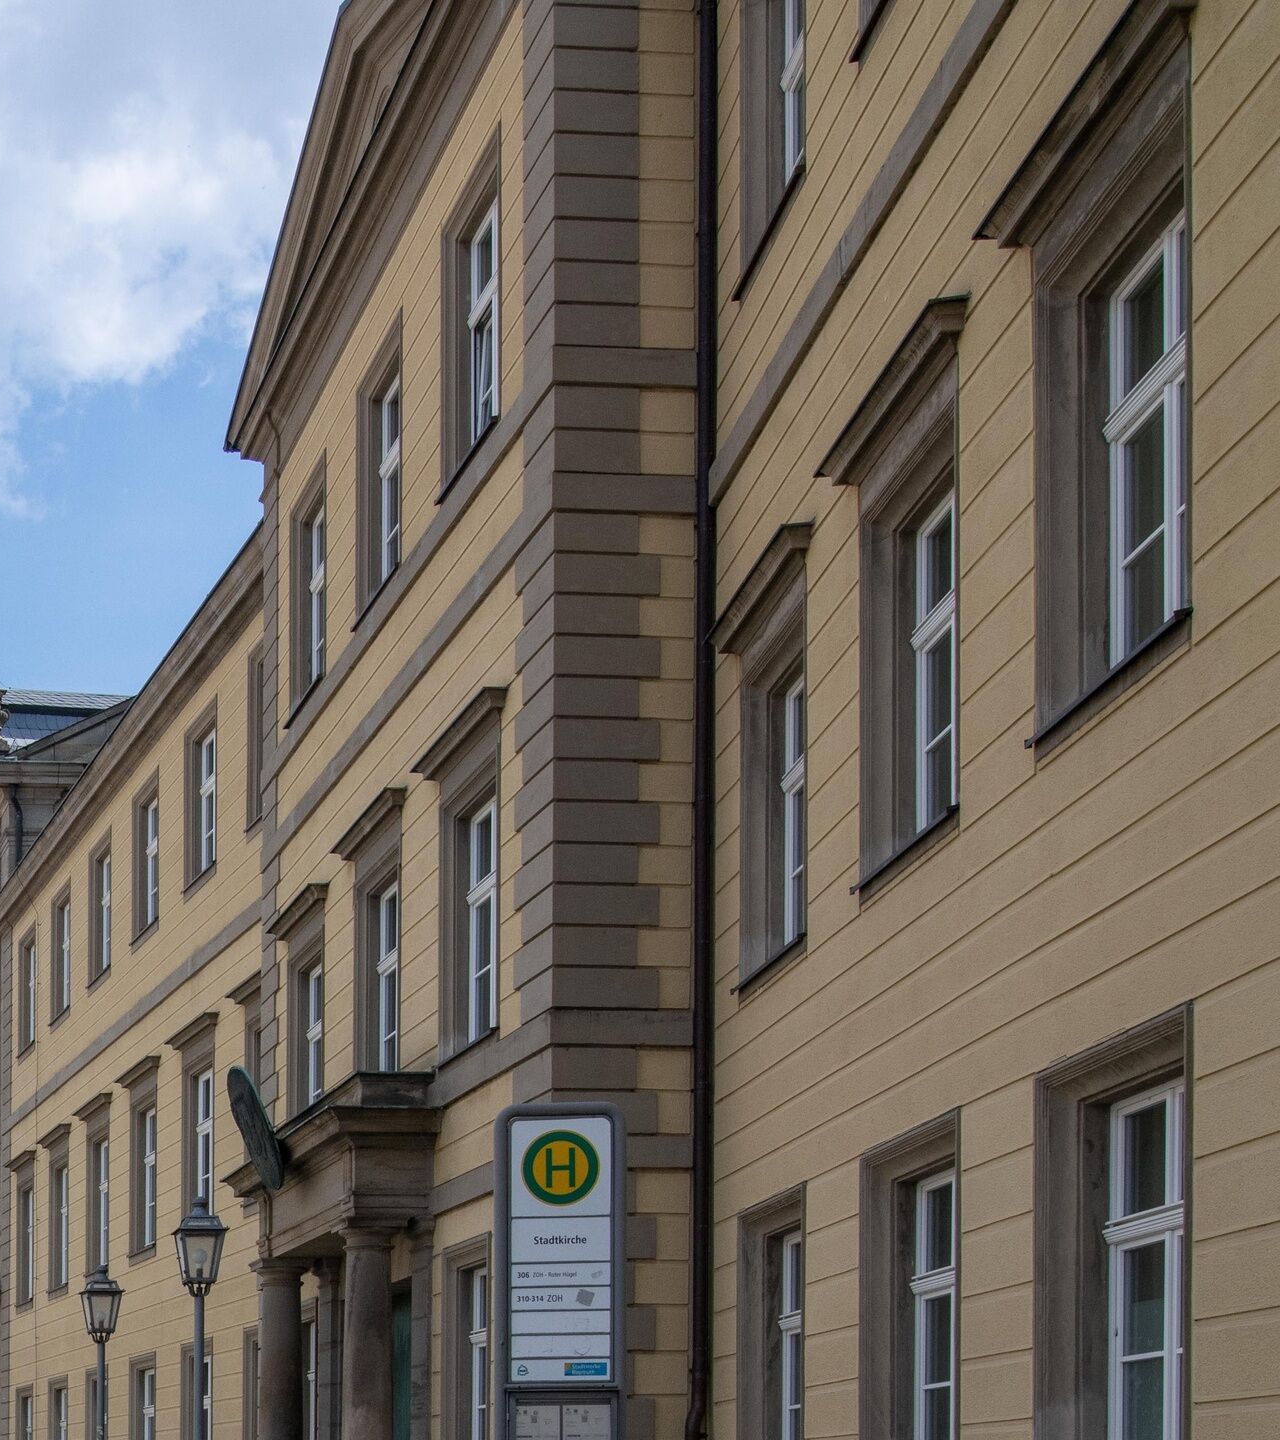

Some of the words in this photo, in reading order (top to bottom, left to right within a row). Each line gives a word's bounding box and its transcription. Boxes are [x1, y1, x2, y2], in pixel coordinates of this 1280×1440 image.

[546, 1147, 575, 1188] H
[533, 1235, 587, 1245] Stadtkirche
[562, 1271, 578, 1279] Hügel
[547, 1294, 563, 1302] ZOH
